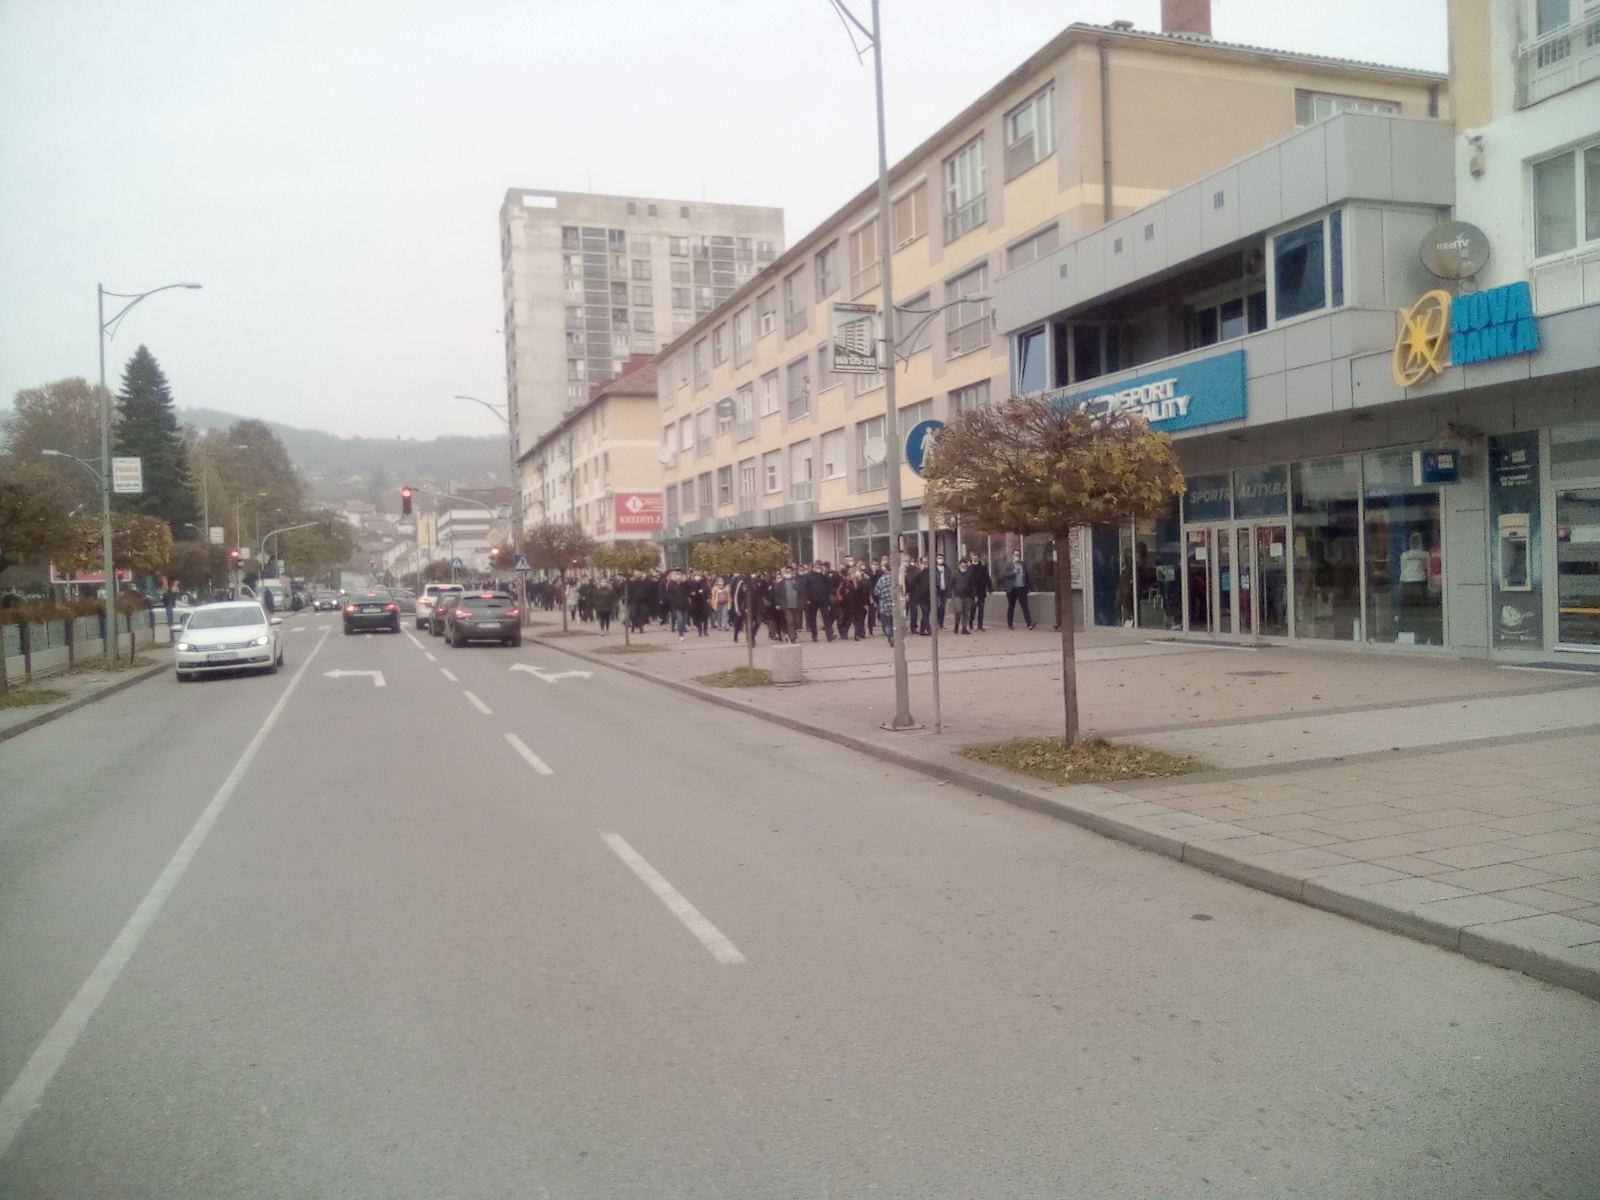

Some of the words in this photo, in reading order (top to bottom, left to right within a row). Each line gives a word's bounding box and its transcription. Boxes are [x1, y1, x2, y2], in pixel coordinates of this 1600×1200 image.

[1451, 281, 1533, 333] NOVA
[1450, 319, 1538, 366] BANKA
[1118, 377, 1178, 410] SPORT
